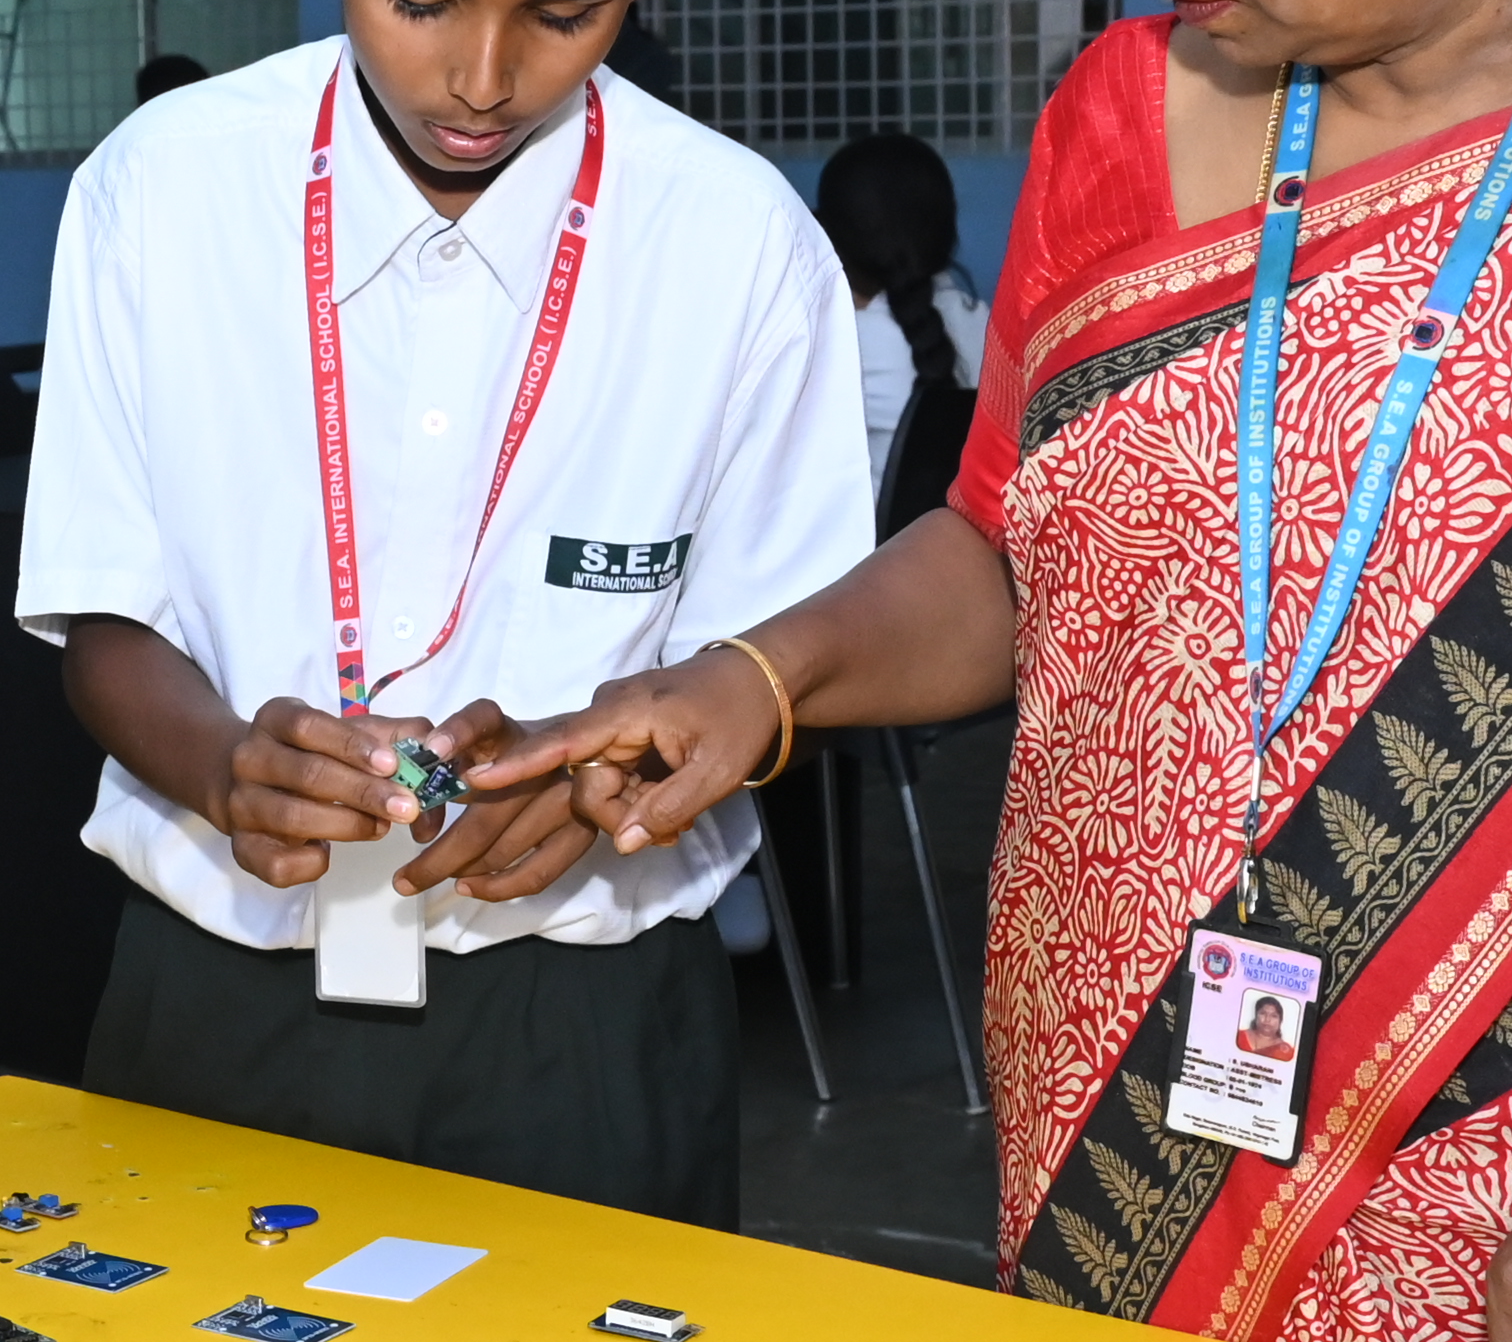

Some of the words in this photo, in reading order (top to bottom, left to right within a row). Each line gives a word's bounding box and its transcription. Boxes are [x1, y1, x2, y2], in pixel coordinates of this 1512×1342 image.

[316, 285, 336, 372] SCHOOL
[513, 340, 552, 424] SCHOOL
[1248, 295, 1276, 447] INSTITUTIONS
[322, 376, 349, 544] INTERNATIONAL
[1248, 454, 1264, 484] OF
[1353, 443, 1391, 523] GROUP
[579, 541, 679, 575] S.E.A
[1248, 491, 1264, 570] GROUP
[1341, 528, 1362, 558] OF
[336, 549, 354, 609] S.E.A.
[572, 571, 656, 592] INTERNATIONAL
[1276, 562, 1350, 718] INSTITUTIONS
[1244, 966, 1308, 991] INSTITUTIONS
[1266, 958, 1300, 975] GROUP
[1302, 967, 1315, 979] OF
